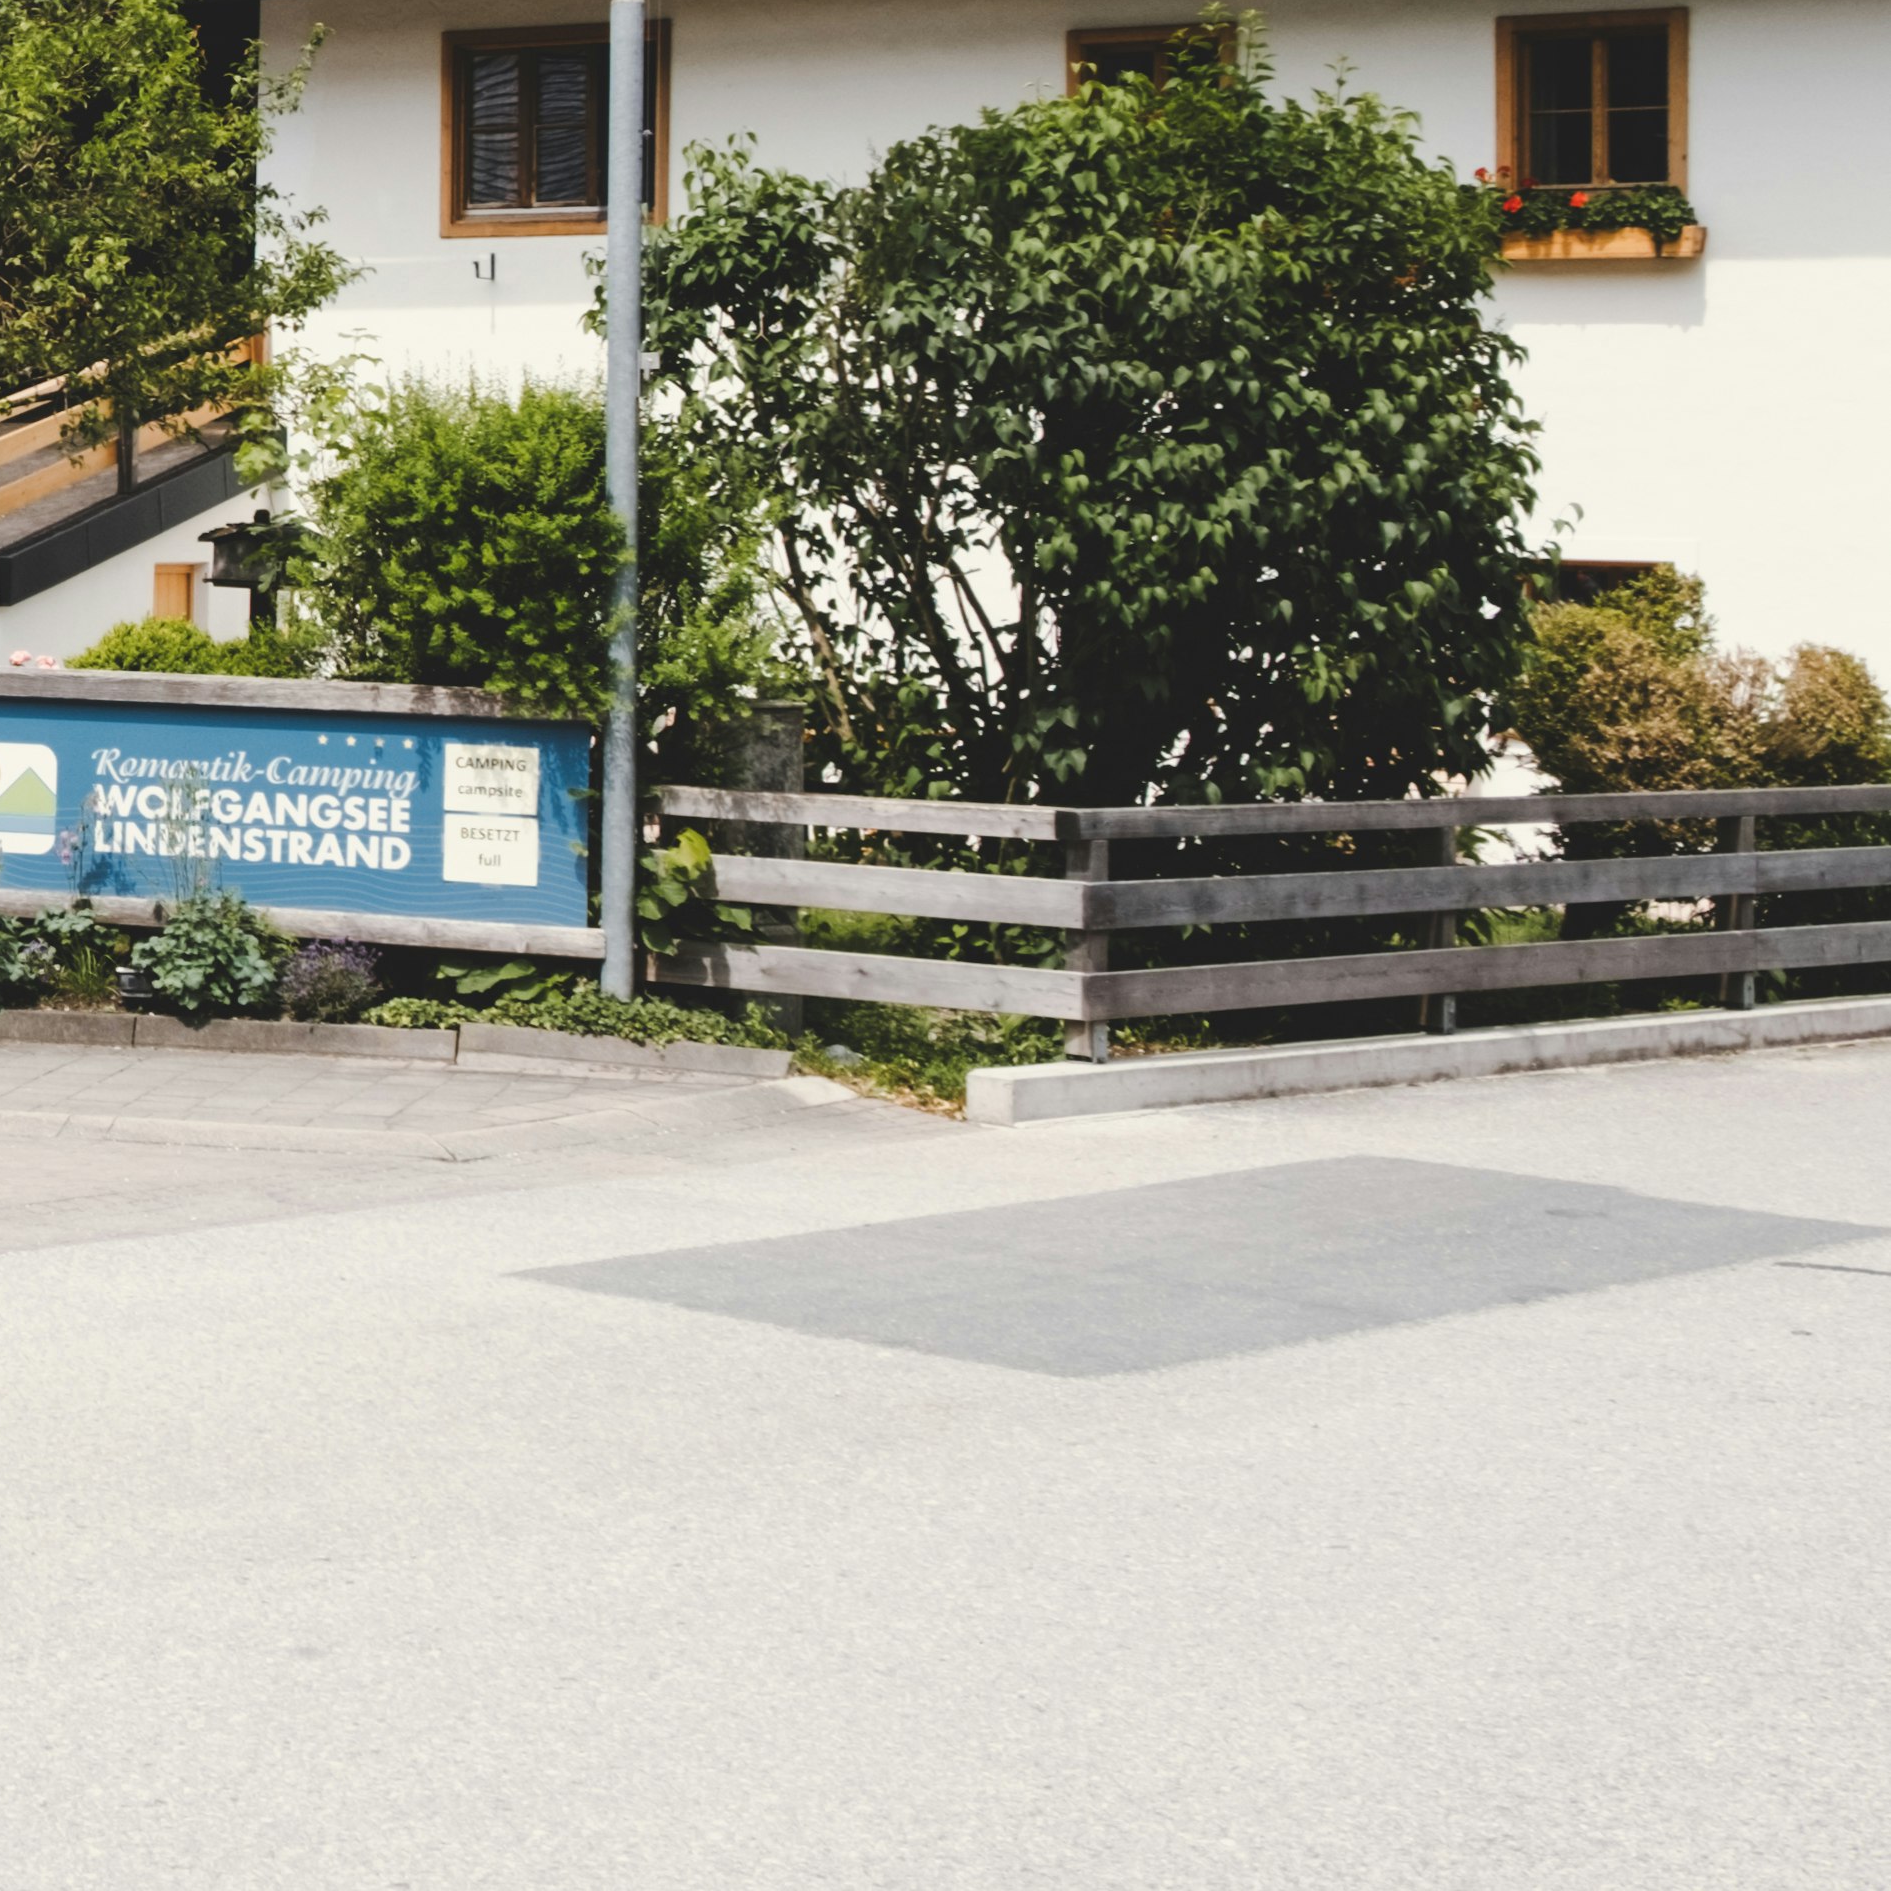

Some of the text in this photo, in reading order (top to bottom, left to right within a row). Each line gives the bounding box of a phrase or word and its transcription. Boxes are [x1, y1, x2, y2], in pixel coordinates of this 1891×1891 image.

[455, 756, 527, 772] CAMPING
[91, 747, 420, 799] Romantik-Camping
[457, 784, 524, 798] campsite
[93, 783, 412, 833] WOLFGANGSEE
[460, 827, 521, 842] BESETZT
[93, 819, 412, 870] LINDENSTRAND
[478, 853, 502, 866] full
